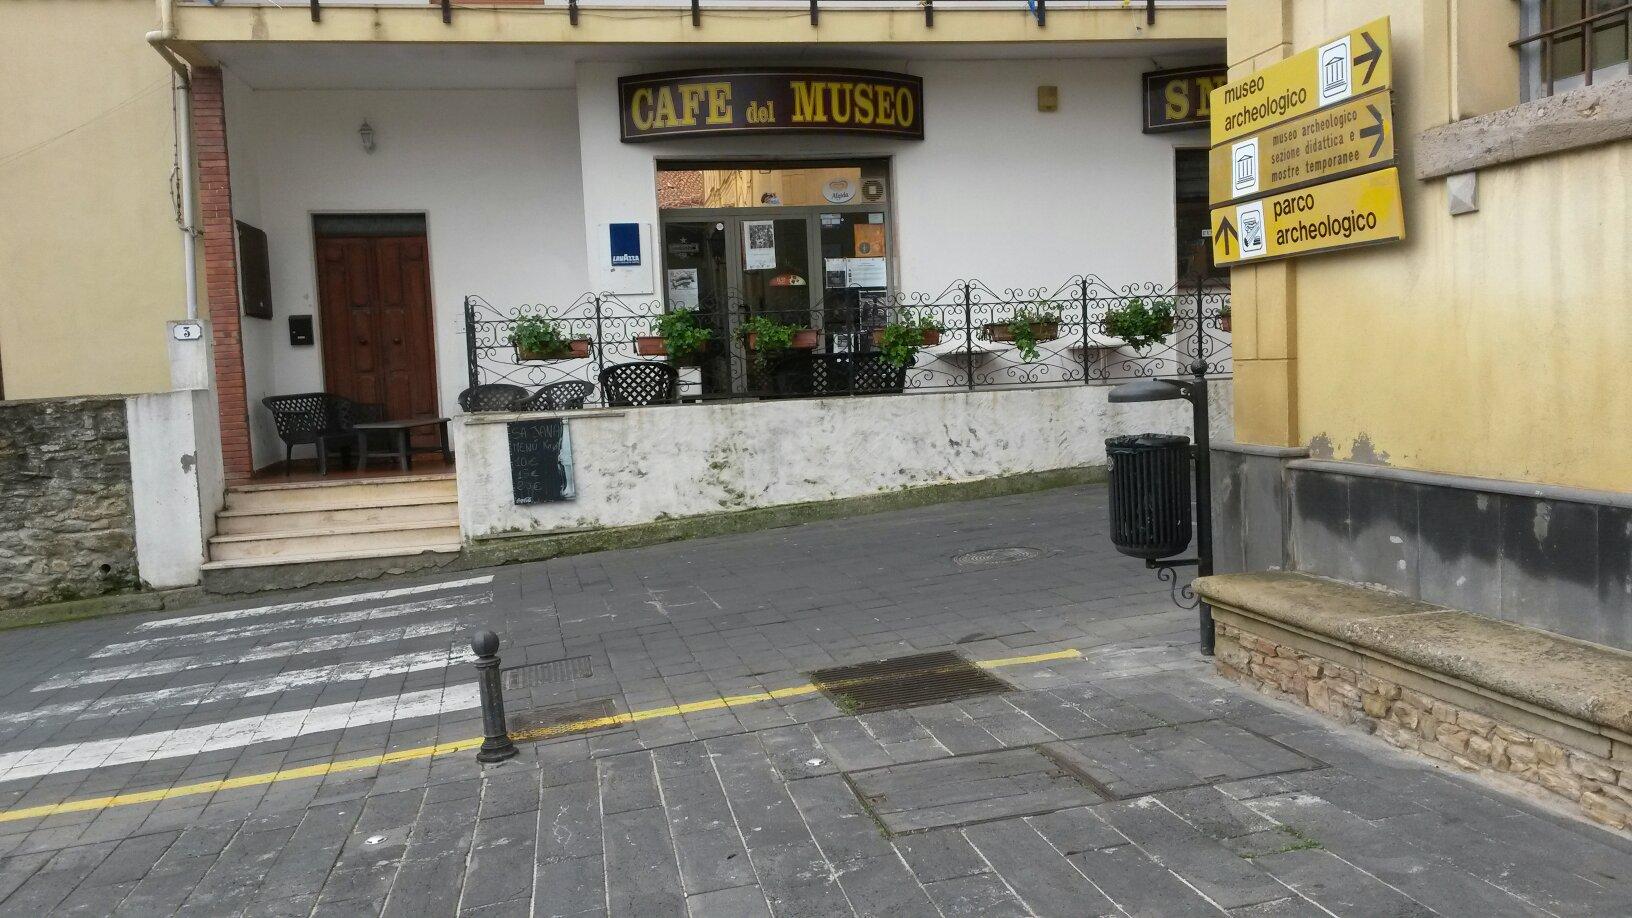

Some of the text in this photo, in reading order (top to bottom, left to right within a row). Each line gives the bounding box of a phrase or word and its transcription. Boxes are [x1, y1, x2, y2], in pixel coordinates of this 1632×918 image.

[631, 81, 914, 130] CAFE del MUSEO
[1224, 74, 1265, 104] museo
[1224, 86, 1307, 131] archeologico
[1272, 109, 1358, 146] museo archeologico
[1271, 130, 1355, 165] sezione didattica e
[1271, 151, 1360, 183] mostre temporanee
[1273, 192, 1315, 221] parco
[1276, 209, 1377, 246] archeologico
[183, 327, 190, 337] 3
